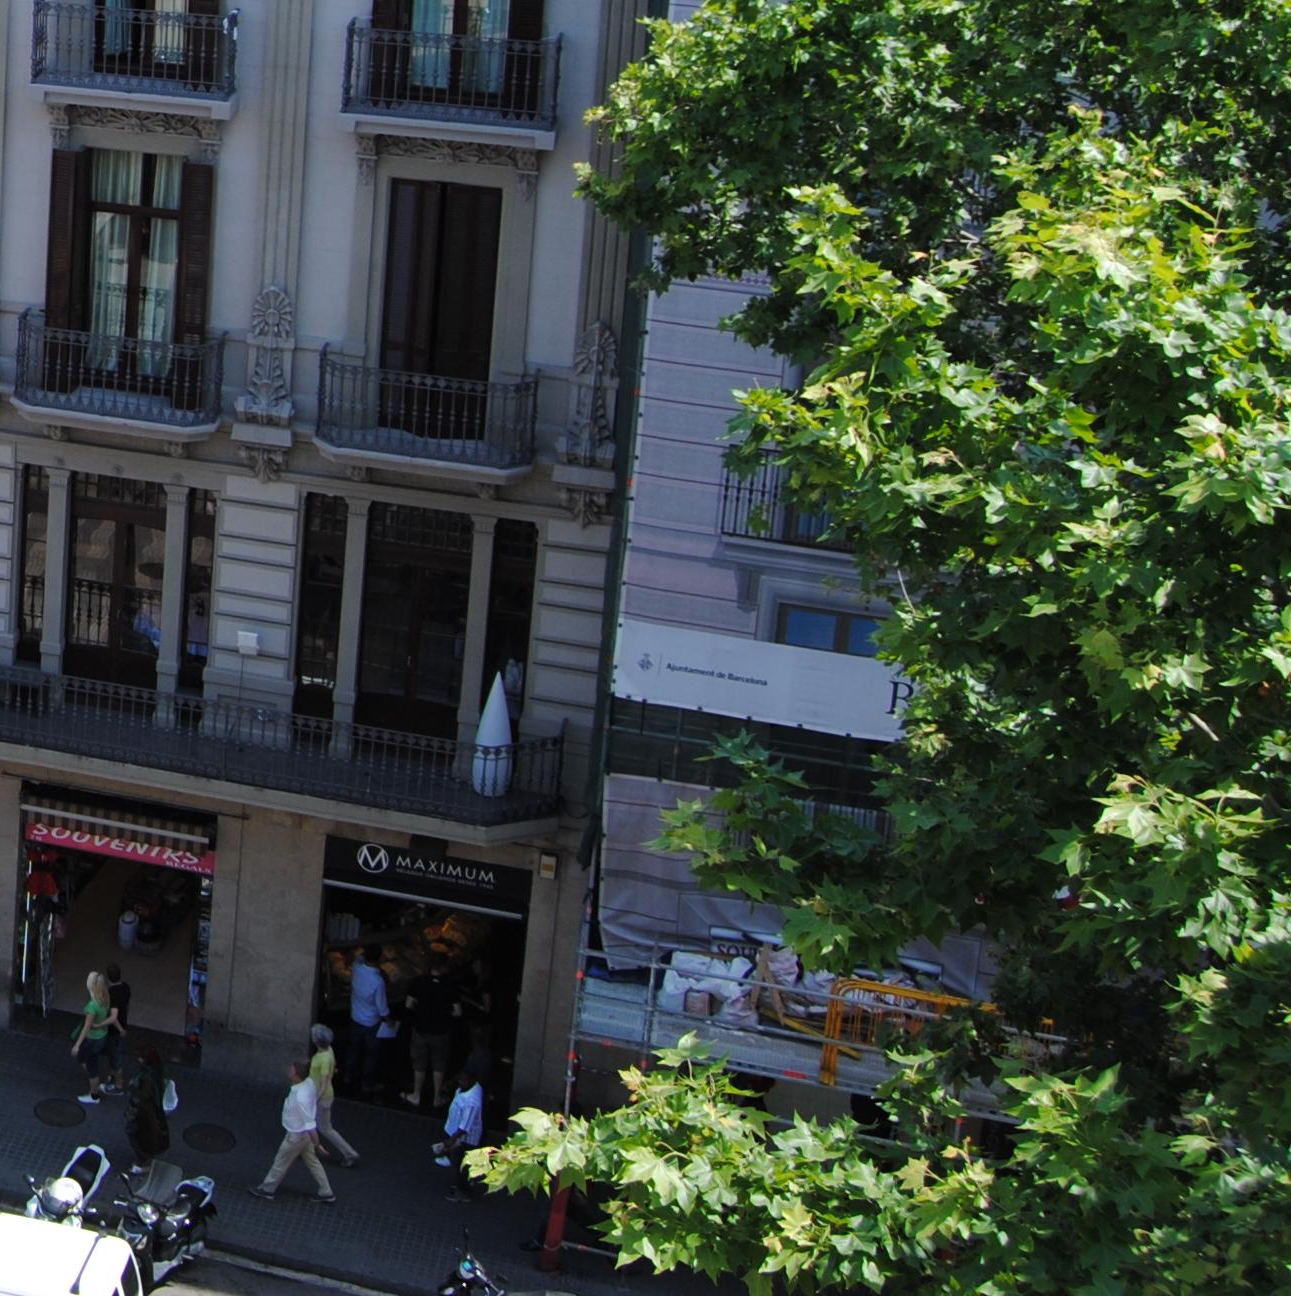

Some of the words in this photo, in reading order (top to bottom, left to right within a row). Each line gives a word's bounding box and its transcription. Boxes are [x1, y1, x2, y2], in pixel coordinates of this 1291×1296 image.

[666, 663, 715, 679] Ajuntament
[716, 670, 725, 680] de
[727, 672, 768, 686] Barcelona
[395, 855, 495, 883] MAXIMUM
